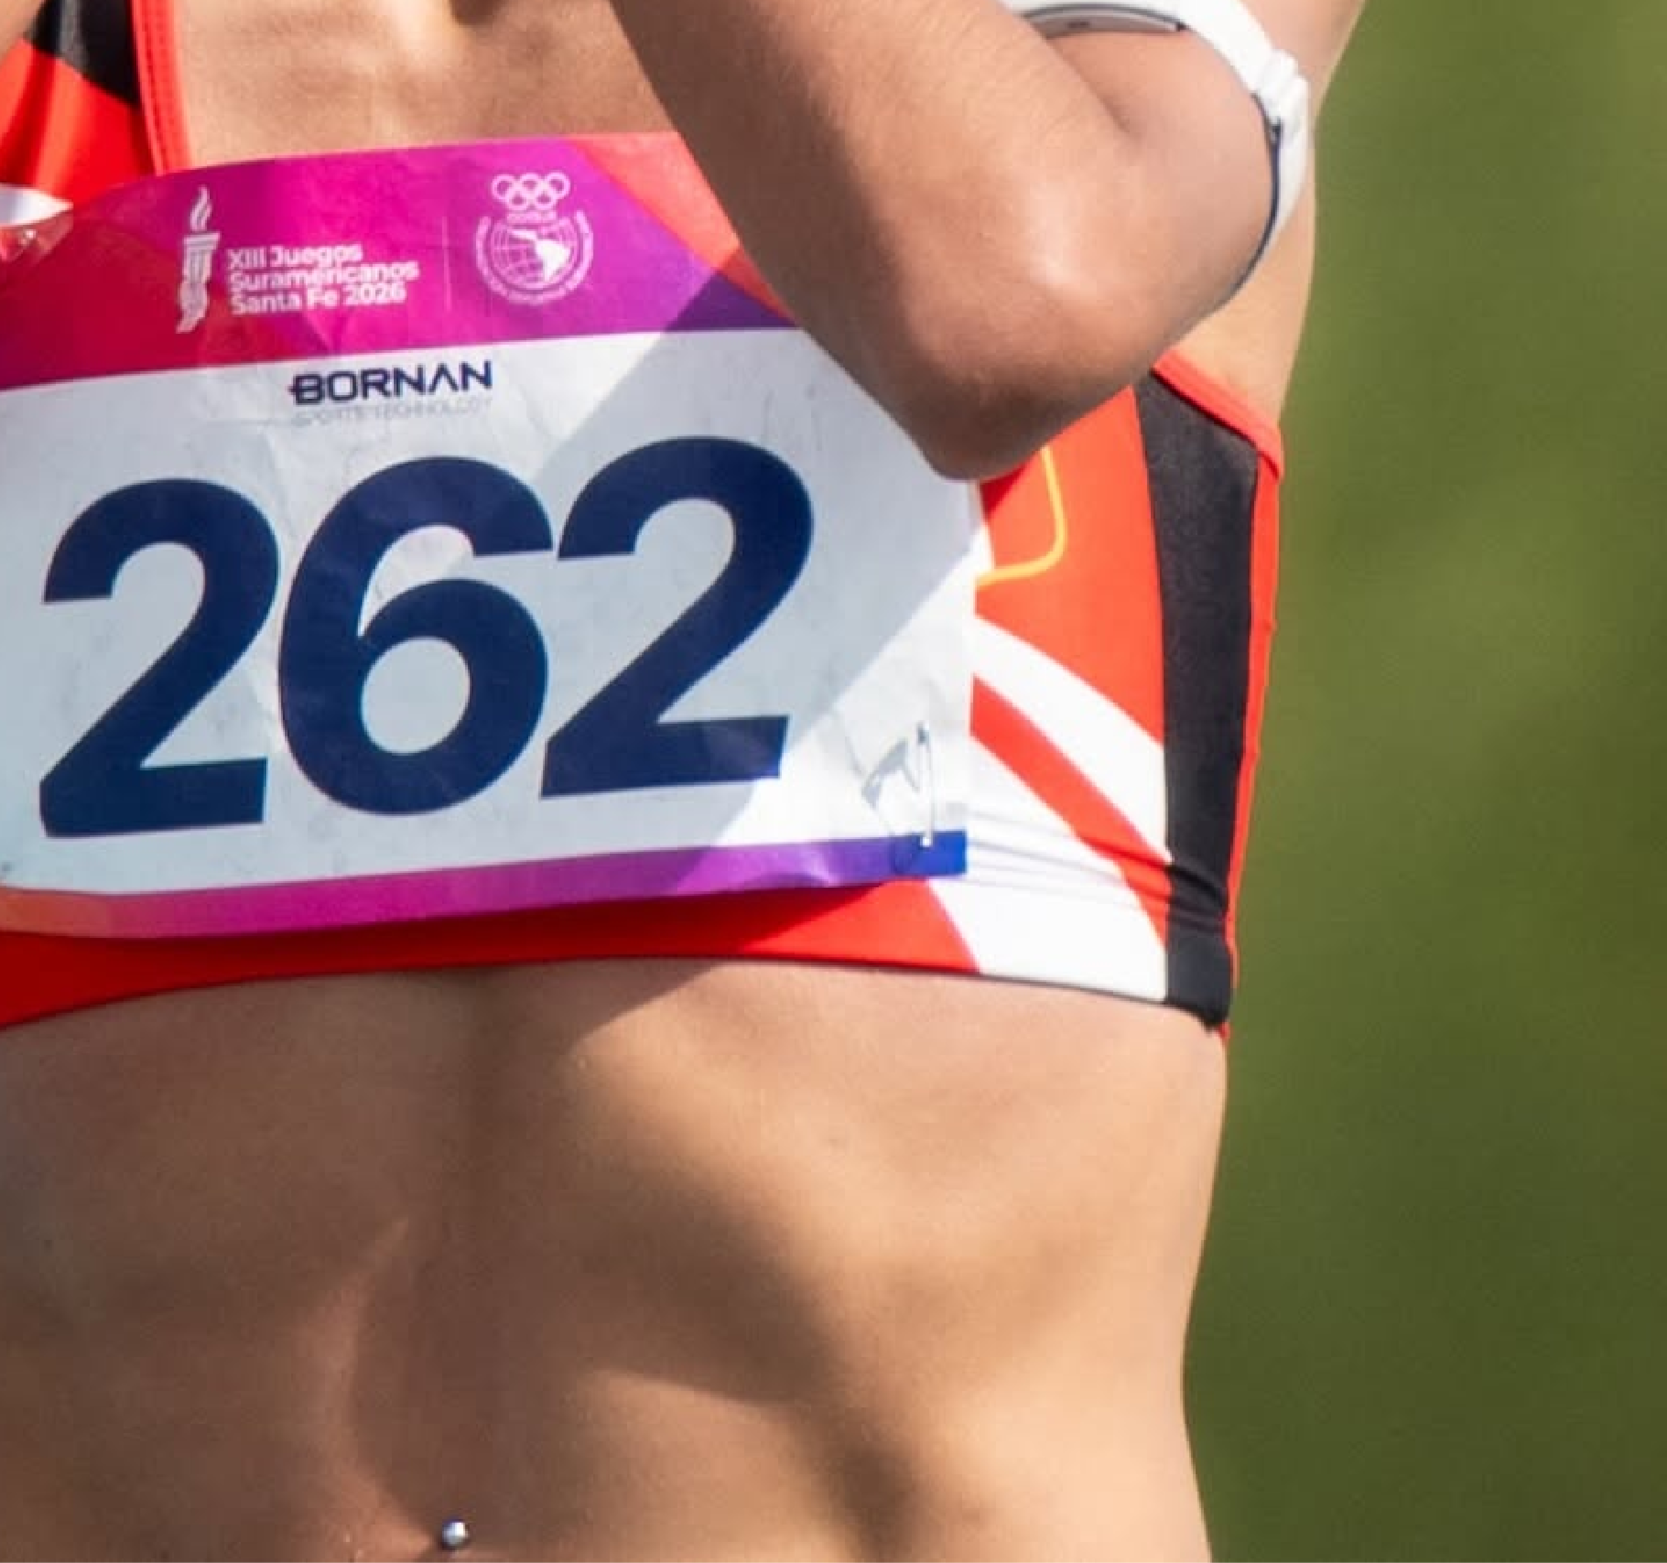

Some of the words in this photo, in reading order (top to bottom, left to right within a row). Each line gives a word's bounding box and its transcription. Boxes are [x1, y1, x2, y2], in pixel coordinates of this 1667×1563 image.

[269, 243, 364, 268] Juegos
[229, 260, 421, 293] Suramericanos
[231, 291, 302, 315] Santa
[306, 286, 341, 311] Fe
[342, 280, 408, 307] 2026
[289, 360, 493, 406] BORNAN
[40, 437, 815, 838] 262
